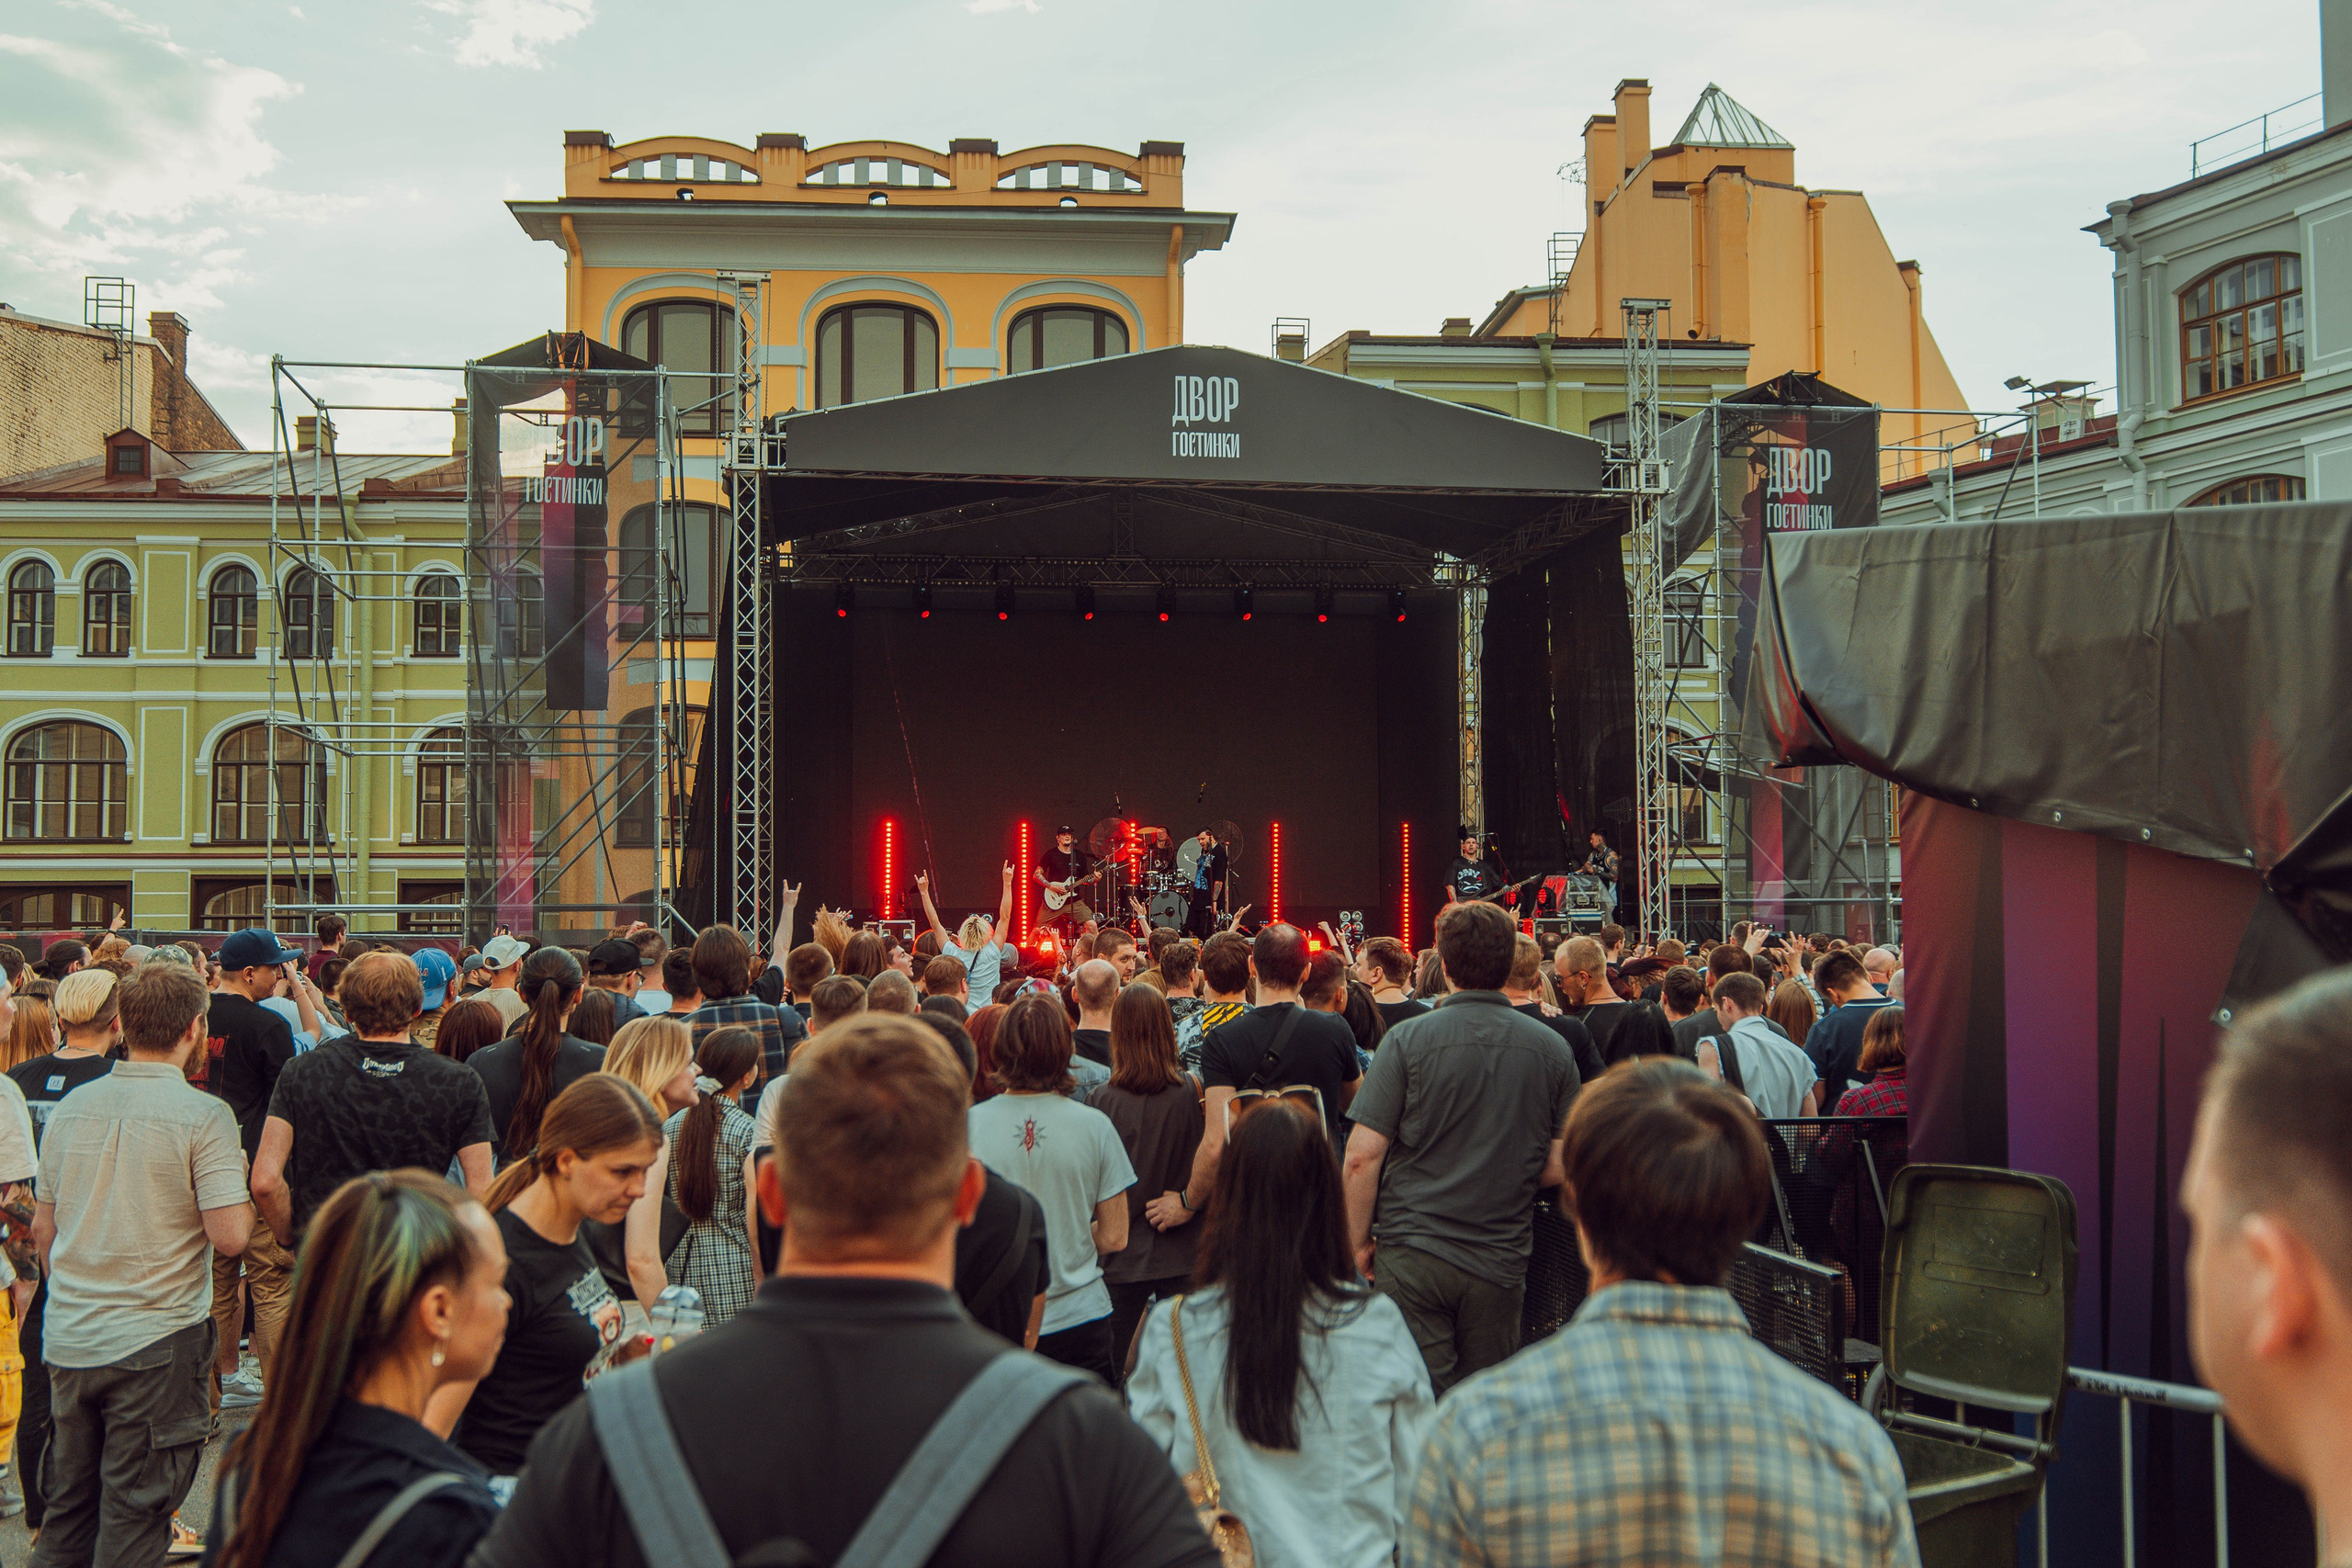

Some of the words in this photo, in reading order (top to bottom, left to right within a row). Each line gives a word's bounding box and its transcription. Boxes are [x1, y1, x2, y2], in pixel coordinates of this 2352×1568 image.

[1171, 376, 1239, 428] ДВОР
[1171, 431, 1240, 458] ГОСТИНКИ
[1766, 446, 1833, 500] ДВОР
[526, 476, 603, 505] ГОСТИНКИ
[1766, 502, 1833, 530] ГОСТИНКИ
